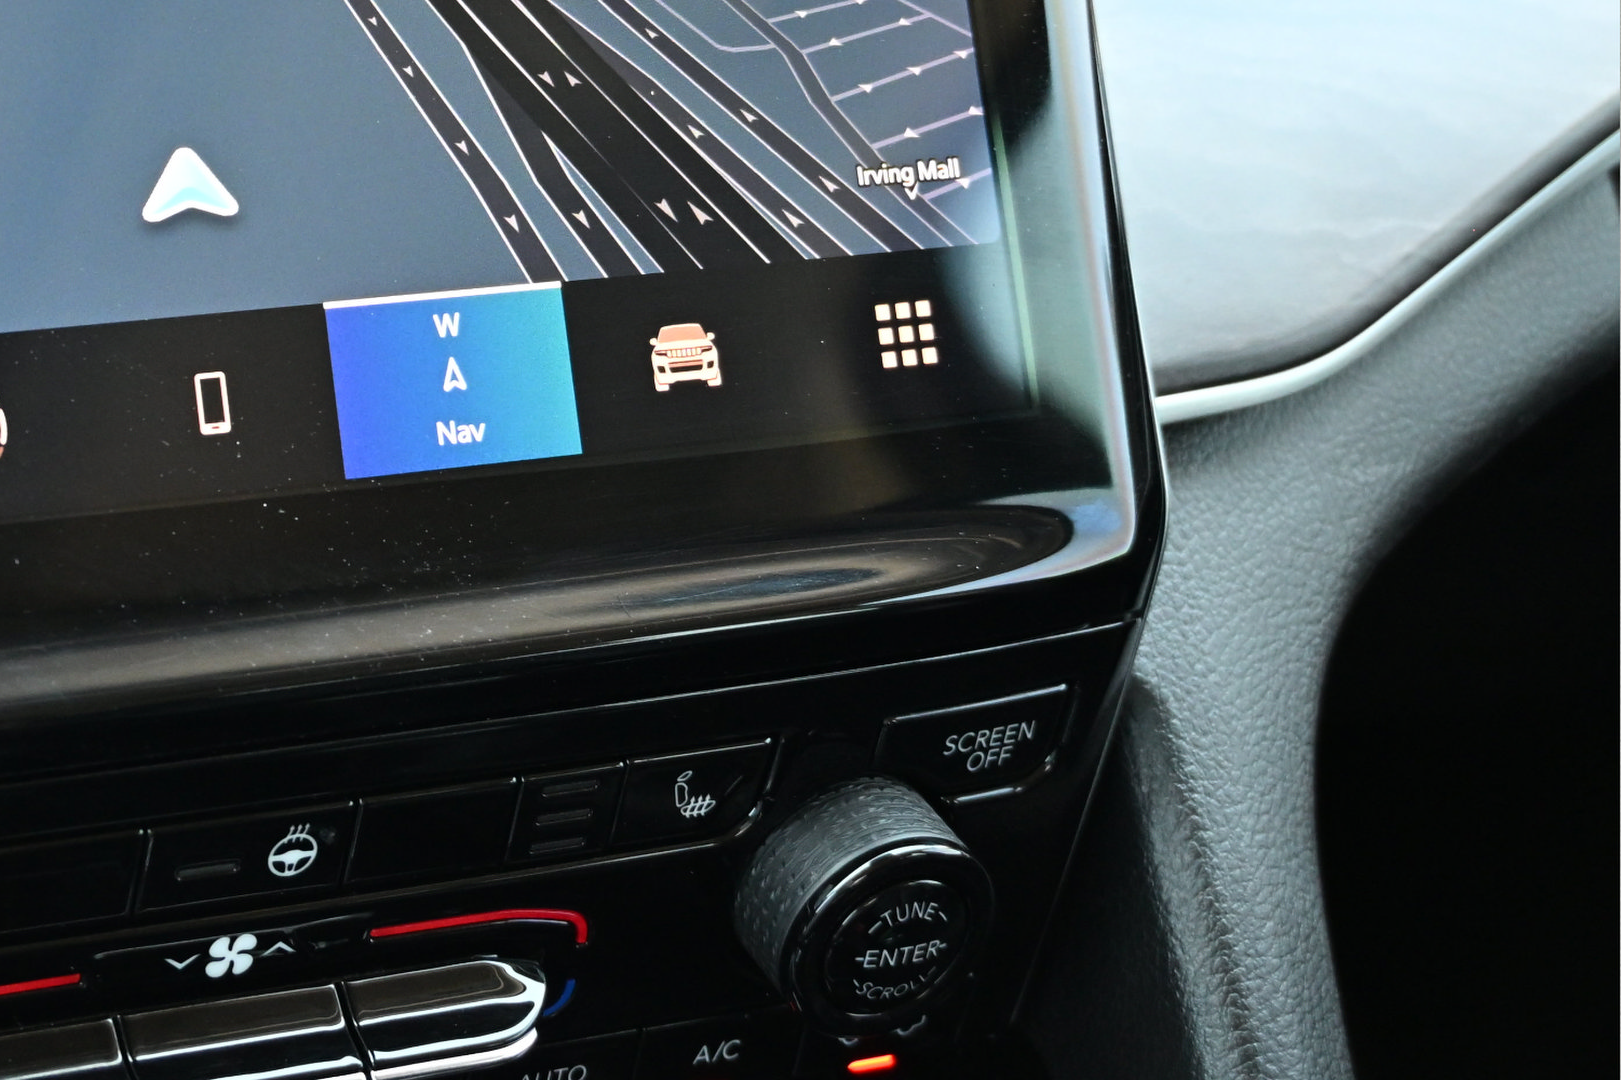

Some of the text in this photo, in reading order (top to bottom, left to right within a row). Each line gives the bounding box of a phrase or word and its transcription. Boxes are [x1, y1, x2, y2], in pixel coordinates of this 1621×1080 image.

[856, 157, 961, 187] Irving Mall
[432, 311, 460, 338] W
[435, 420, 486, 446] Nav
[942, 720, 1036, 756] SCREEN
[966, 745, 1013, 772] OFF
[692, 1039, 741, 1065] A/C
